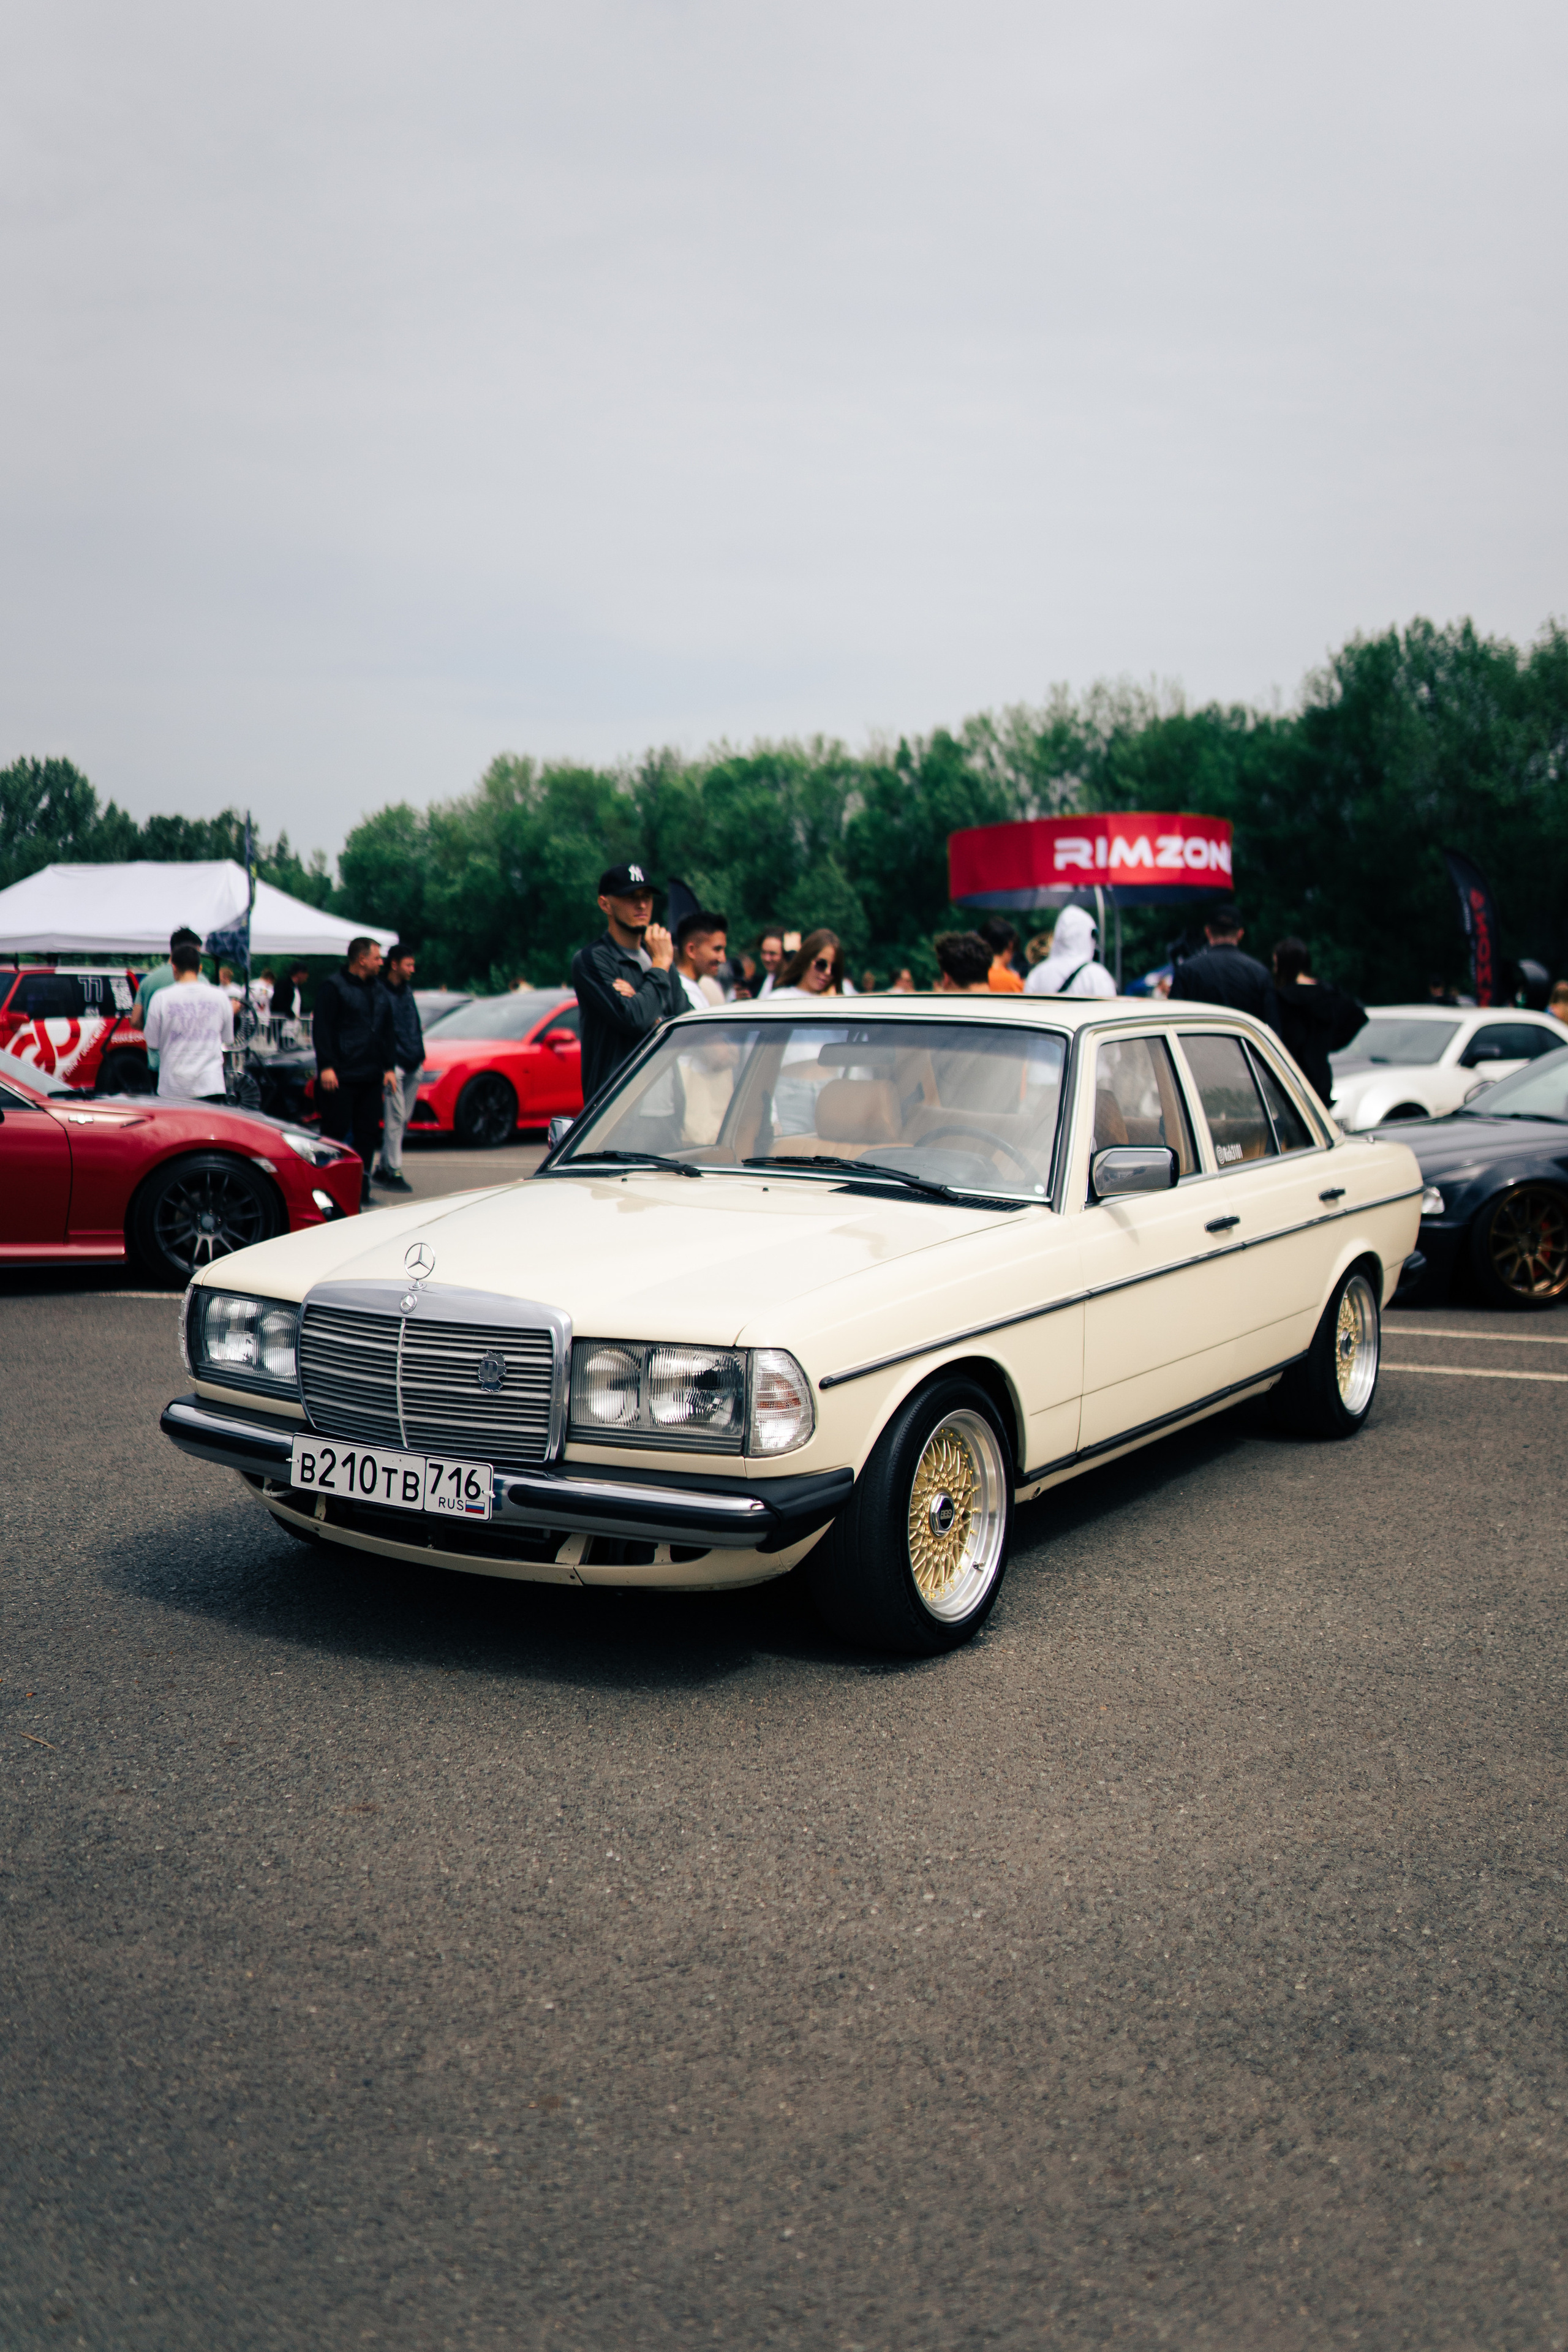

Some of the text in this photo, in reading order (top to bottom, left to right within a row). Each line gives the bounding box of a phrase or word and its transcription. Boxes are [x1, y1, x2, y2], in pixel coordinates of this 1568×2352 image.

[1054, 835, 1232, 875] RIMZON
[428, 1463, 481, 1500] 716
[438, 1496, 464, 1511] RUS
